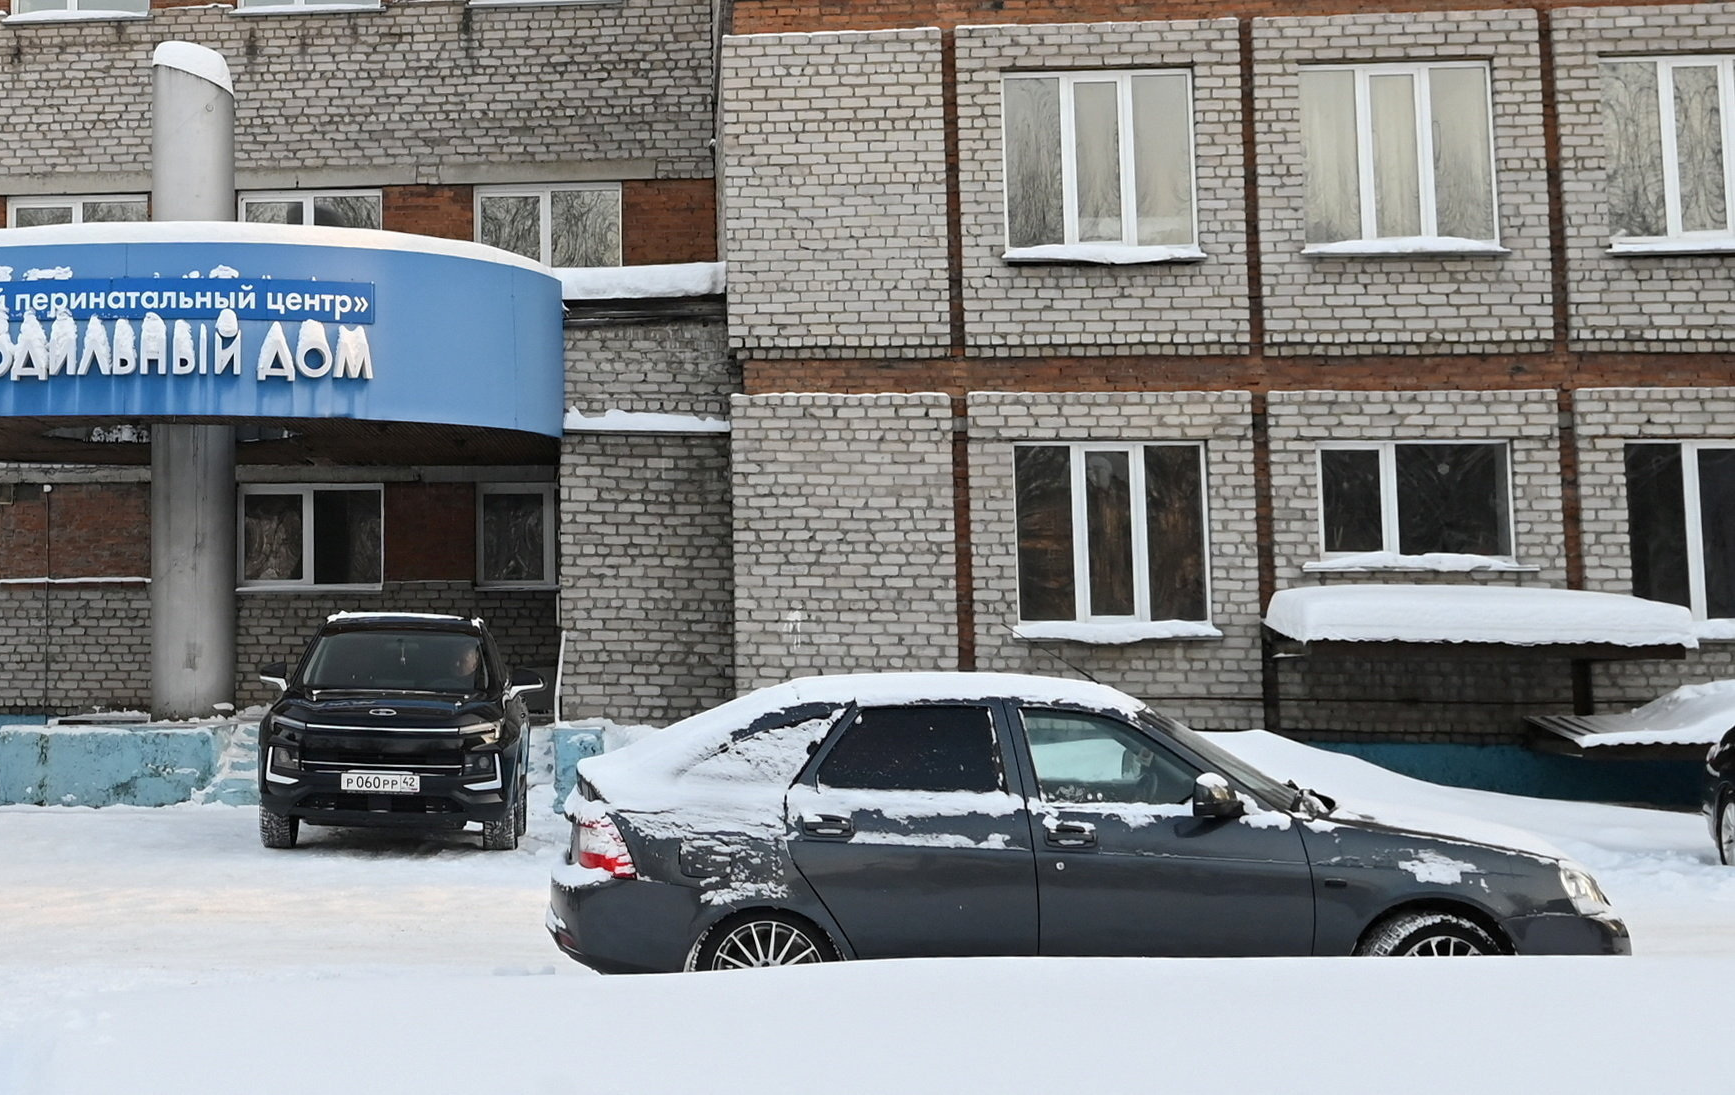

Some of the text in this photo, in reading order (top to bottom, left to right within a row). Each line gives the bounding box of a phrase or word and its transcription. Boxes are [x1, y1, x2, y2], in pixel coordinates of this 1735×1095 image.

[15, 284, 256, 318] перинатальный
[267, 292, 369, 320] центр»
[256, 328, 374, 382] ДОМ
